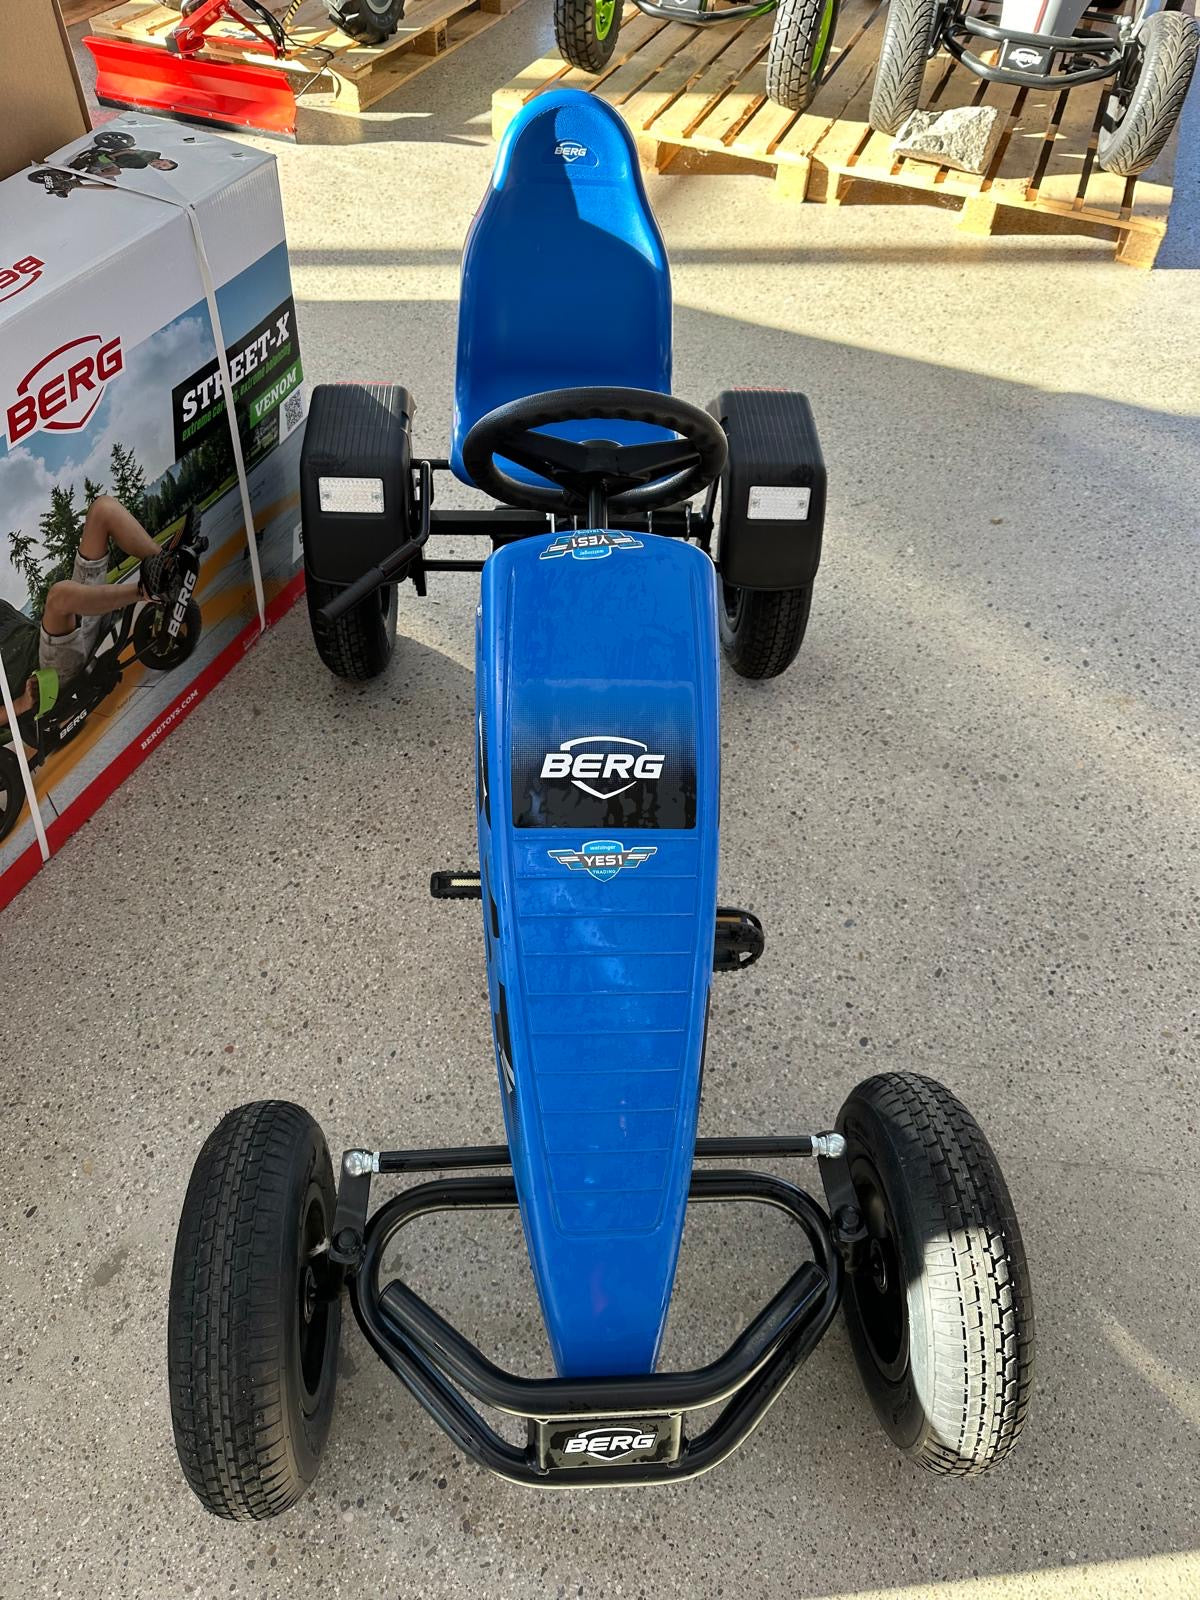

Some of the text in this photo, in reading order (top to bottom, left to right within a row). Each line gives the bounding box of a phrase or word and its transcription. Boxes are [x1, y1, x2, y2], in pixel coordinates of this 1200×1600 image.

[554, 146, 588, 157] BERG
[0, 255, 46, 289] BE
[7, 336, 123, 443] BERG
[255, 367, 297, 417] VENOM
[572, 535, 609, 548] YES1
[167, 569, 198, 638] BERG
[59, 708, 88, 740] BERG
[140, 689, 199, 750] BERGTOYS.COM
[540, 753, 666, 779] BERG
[584, 854, 623, 867] YES1
[564, 1433, 657, 1454] BERG
